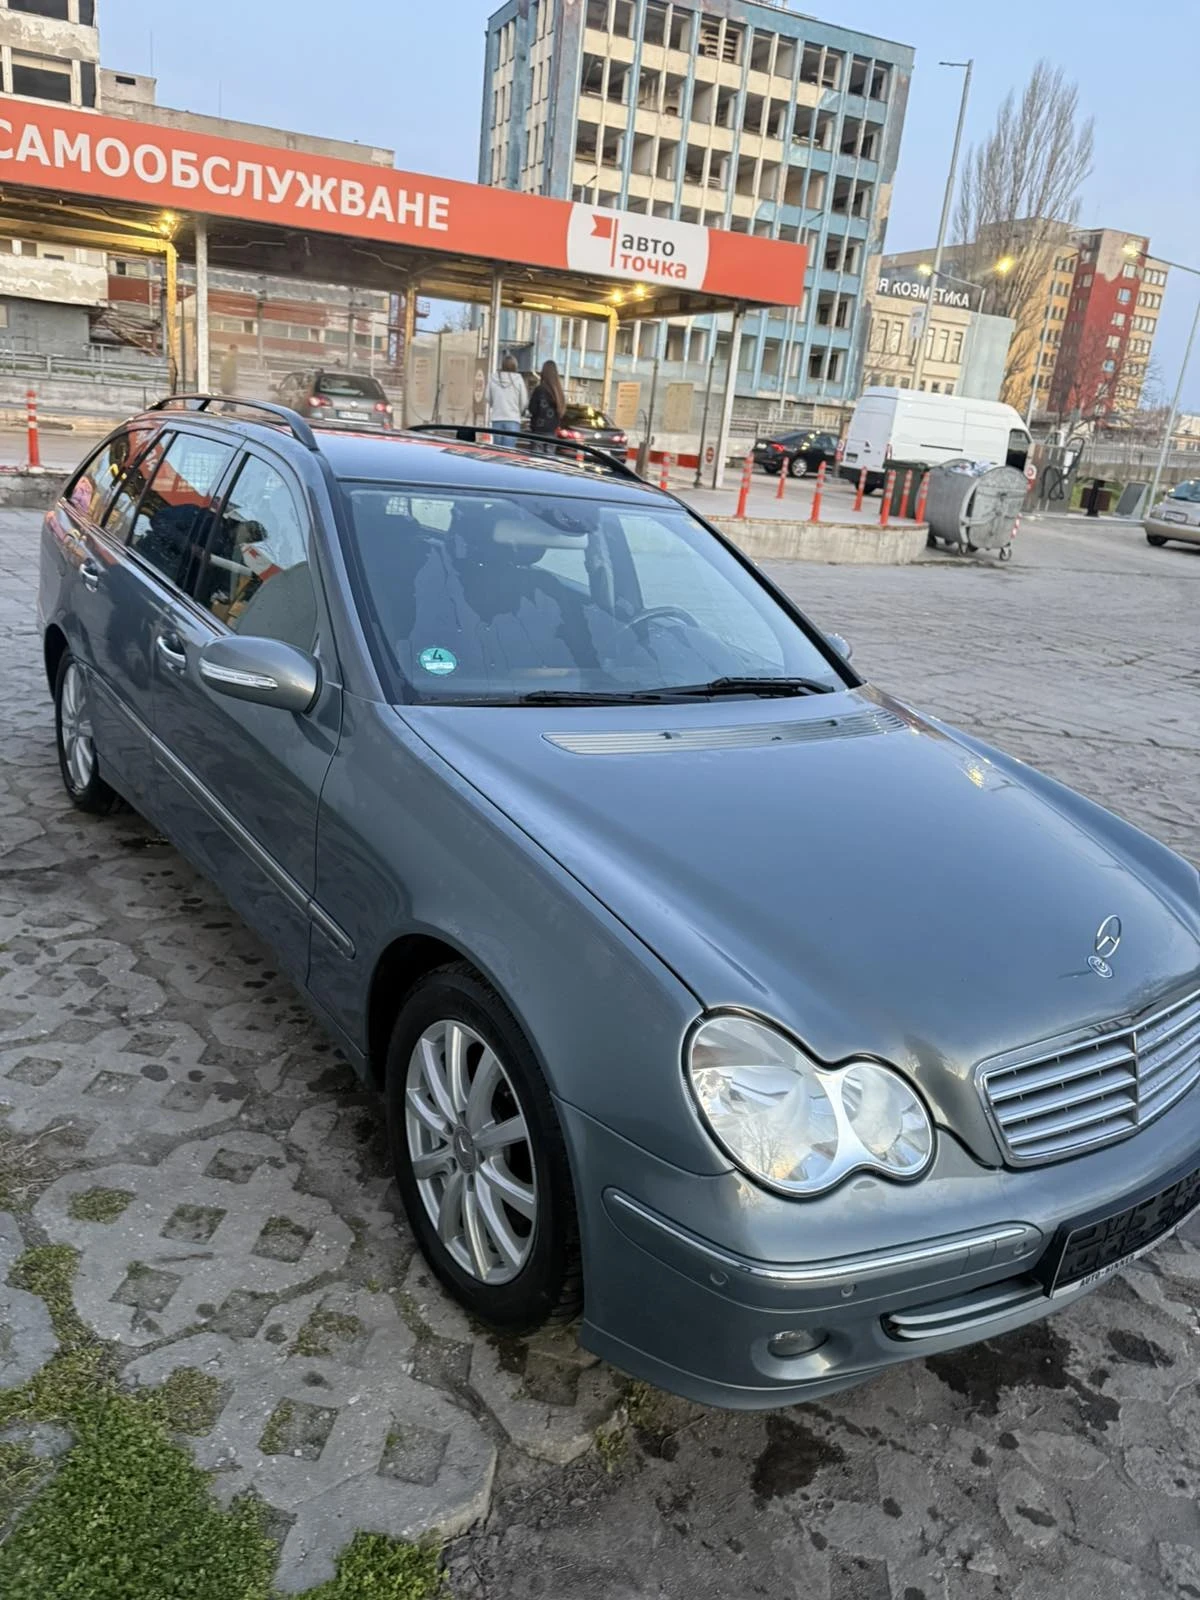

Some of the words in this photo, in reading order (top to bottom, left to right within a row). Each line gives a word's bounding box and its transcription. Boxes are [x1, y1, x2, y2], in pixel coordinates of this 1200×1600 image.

[621, 234, 675, 256] авто
[620, 254, 688, 280] точка
[432, 649, 443, 662] 4
